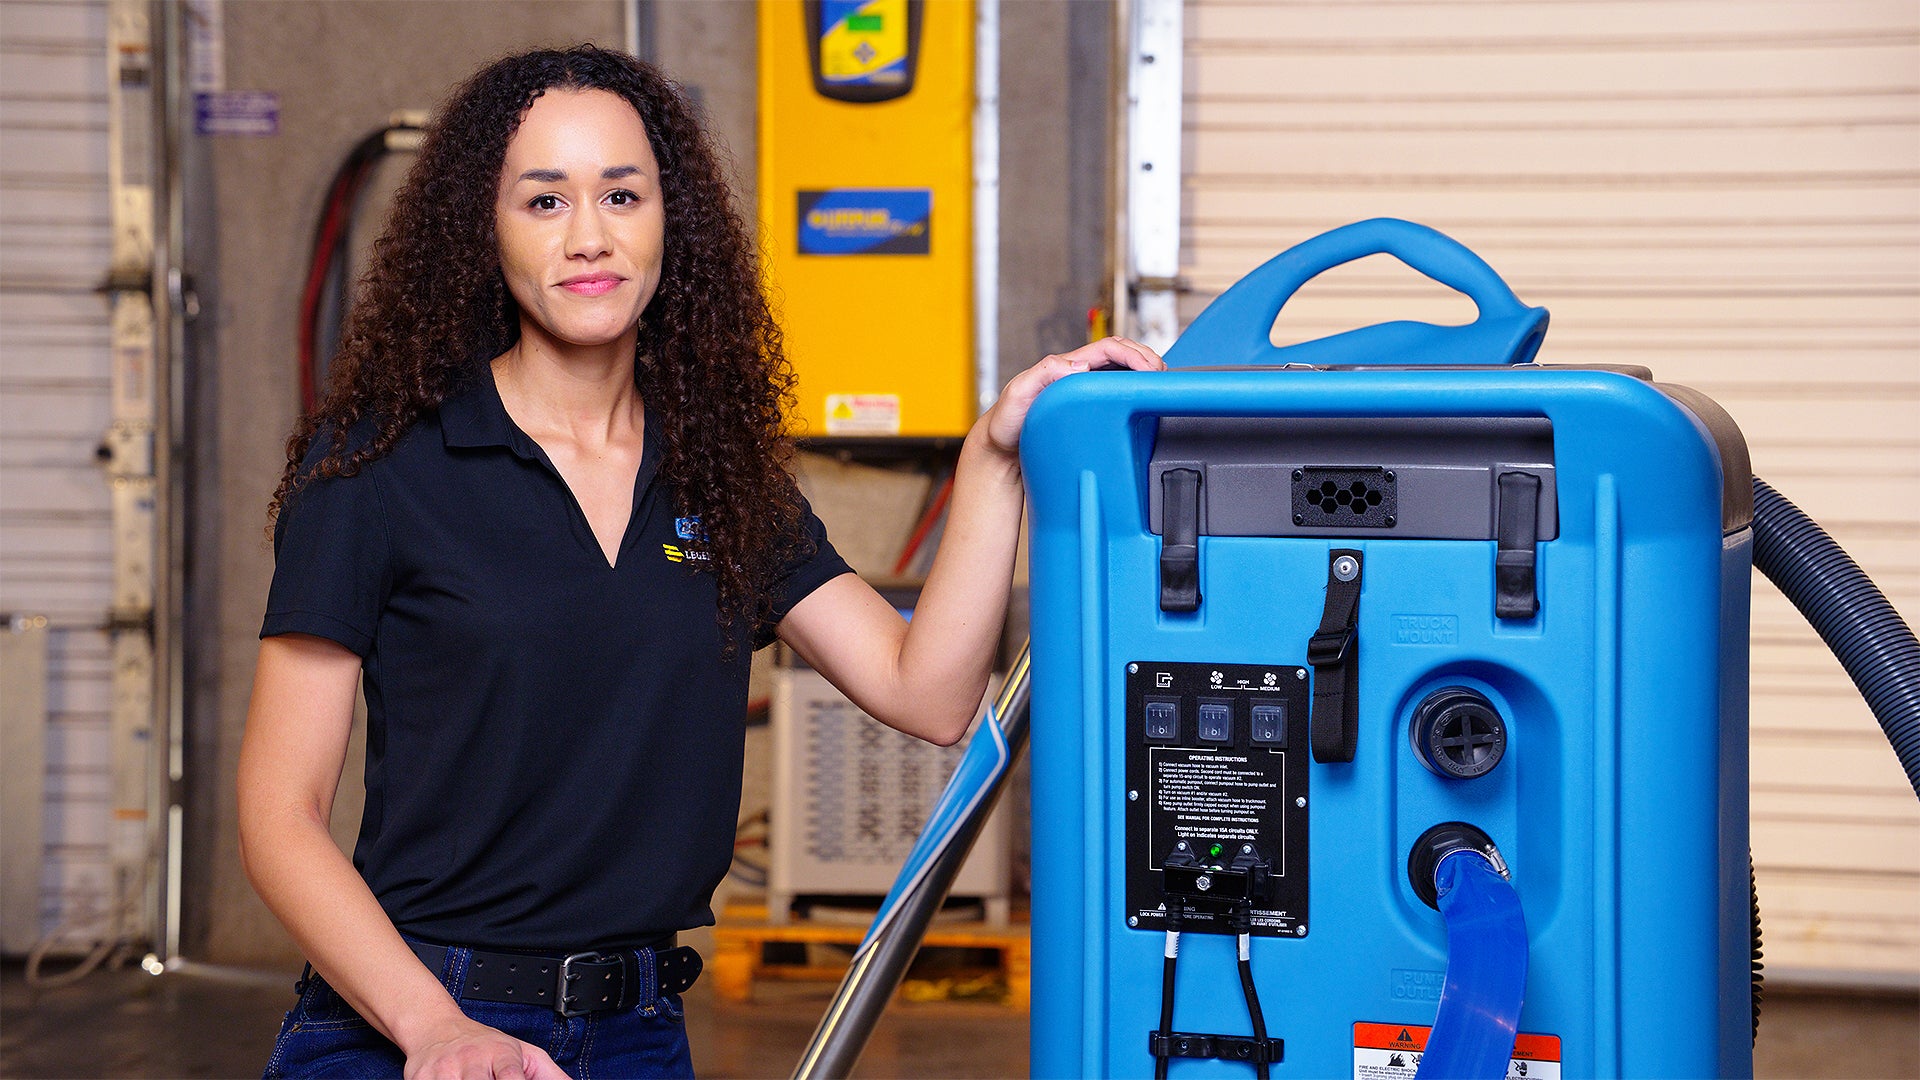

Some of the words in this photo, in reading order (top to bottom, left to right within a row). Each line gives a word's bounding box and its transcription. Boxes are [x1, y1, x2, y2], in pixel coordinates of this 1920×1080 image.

[1397, 616, 1451, 630] TRUCK
[1396, 630, 1453, 644] MOUNT
[1403, 971, 1445, 985] PUMP
